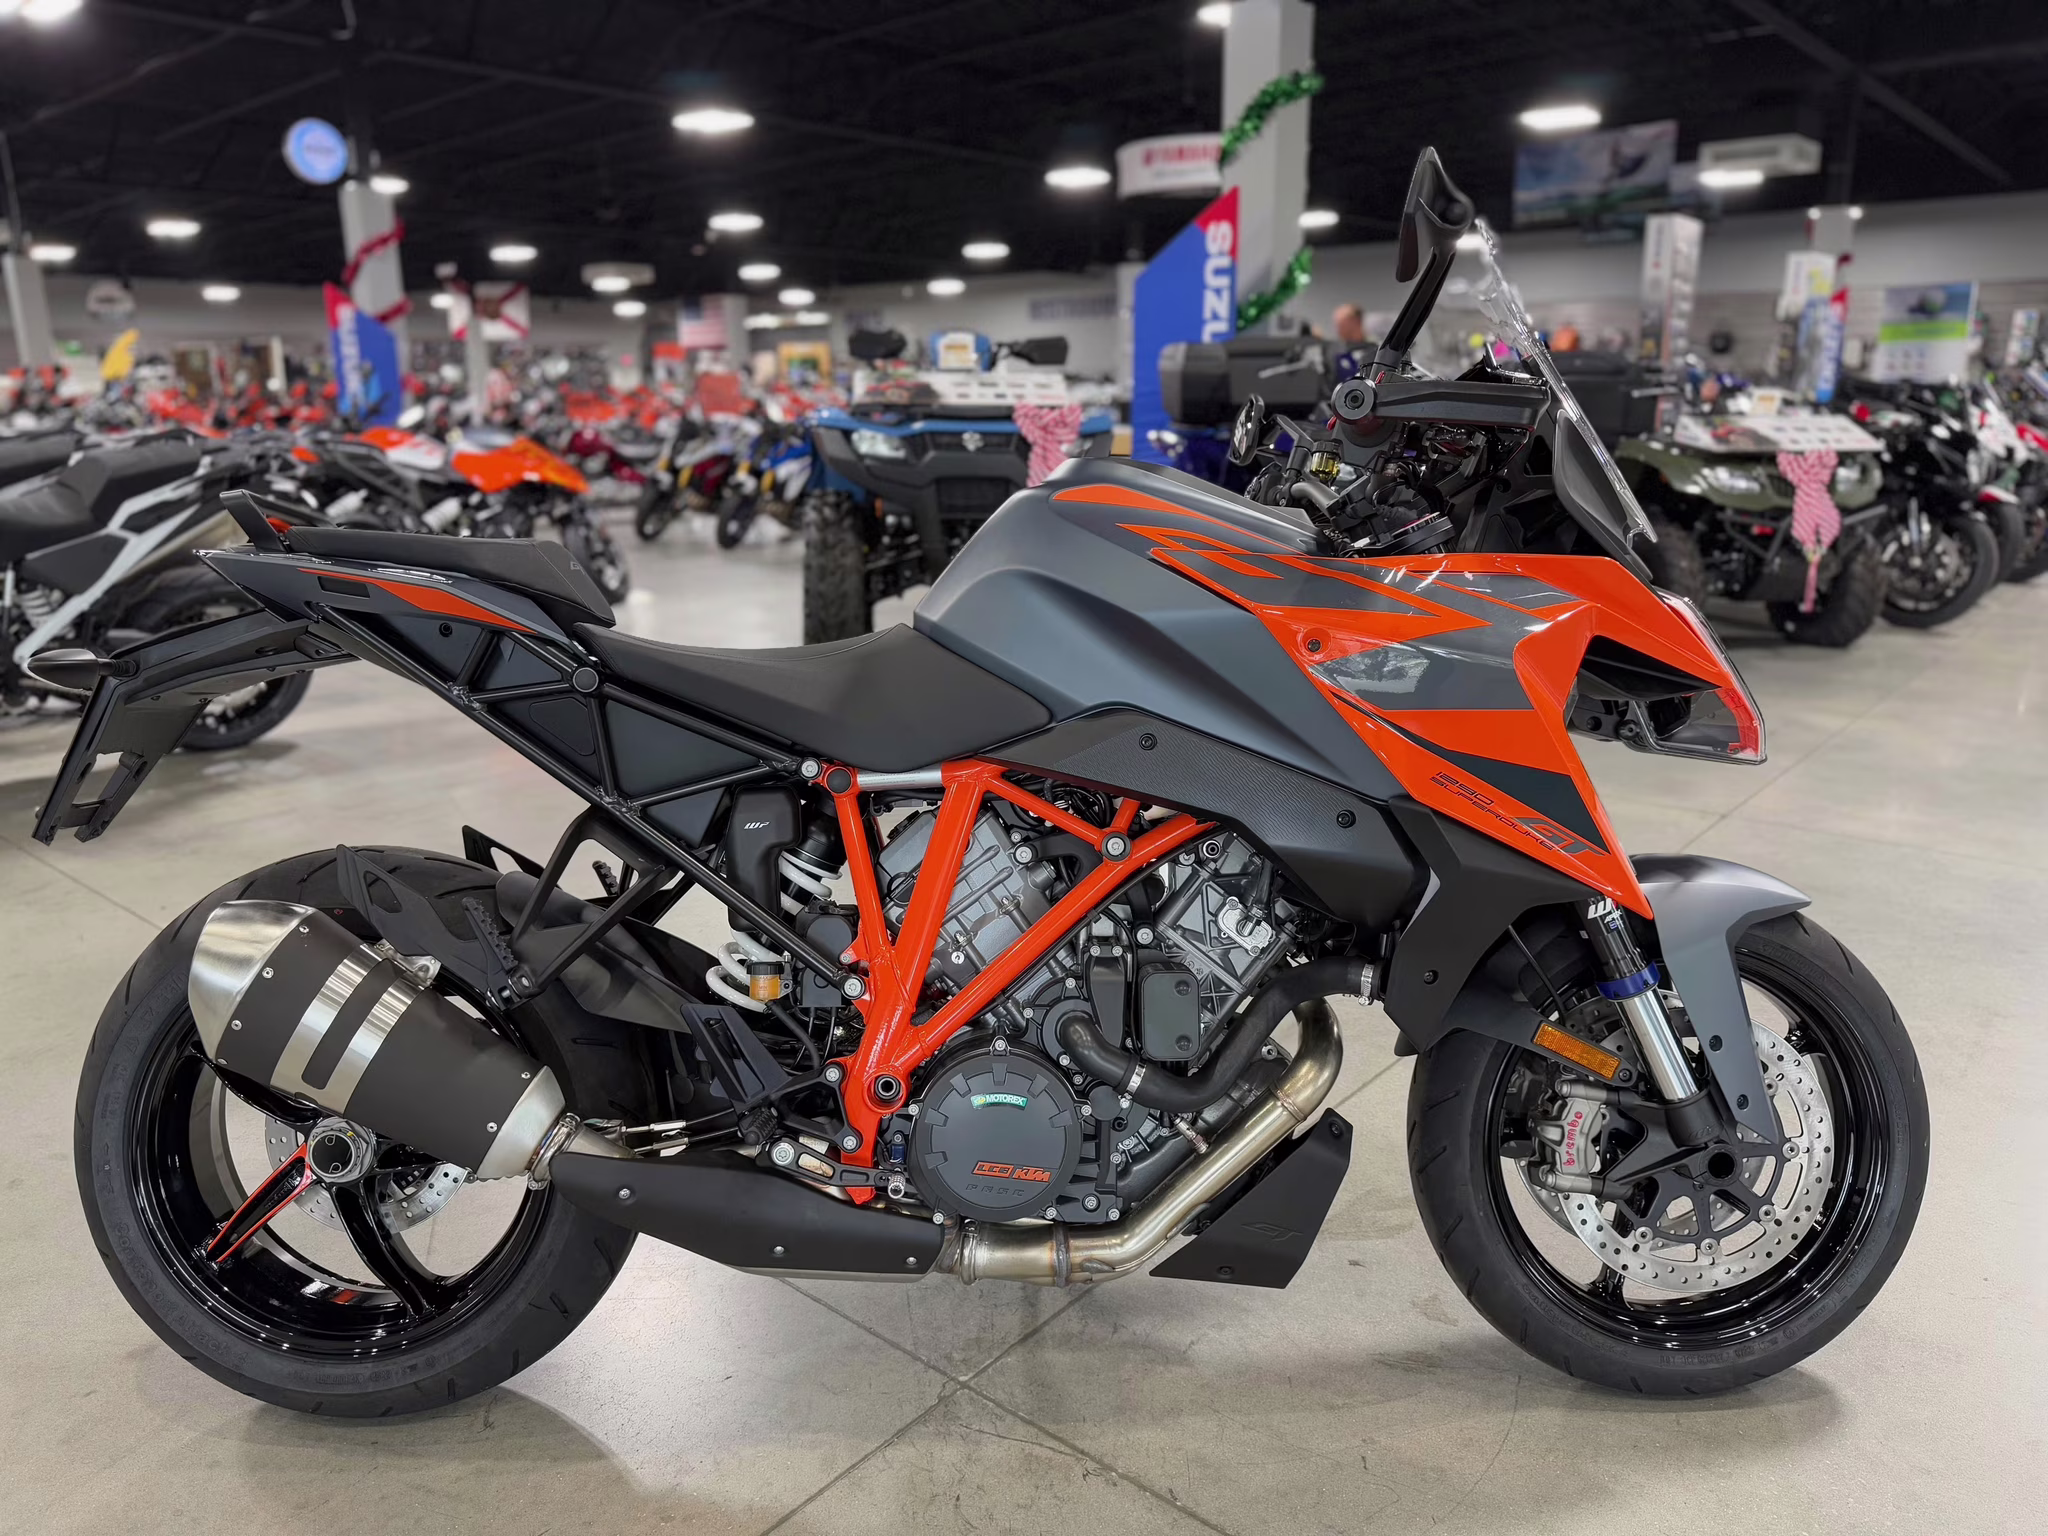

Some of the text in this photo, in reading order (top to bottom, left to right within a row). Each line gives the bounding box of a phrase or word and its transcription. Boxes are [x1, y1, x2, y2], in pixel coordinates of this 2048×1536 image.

[986, 1094, 1025, 1106] MOTOREX
[1563, 1111, 1583, 1166] brembo
[1012, 1166, 1051, 1182] KTM
